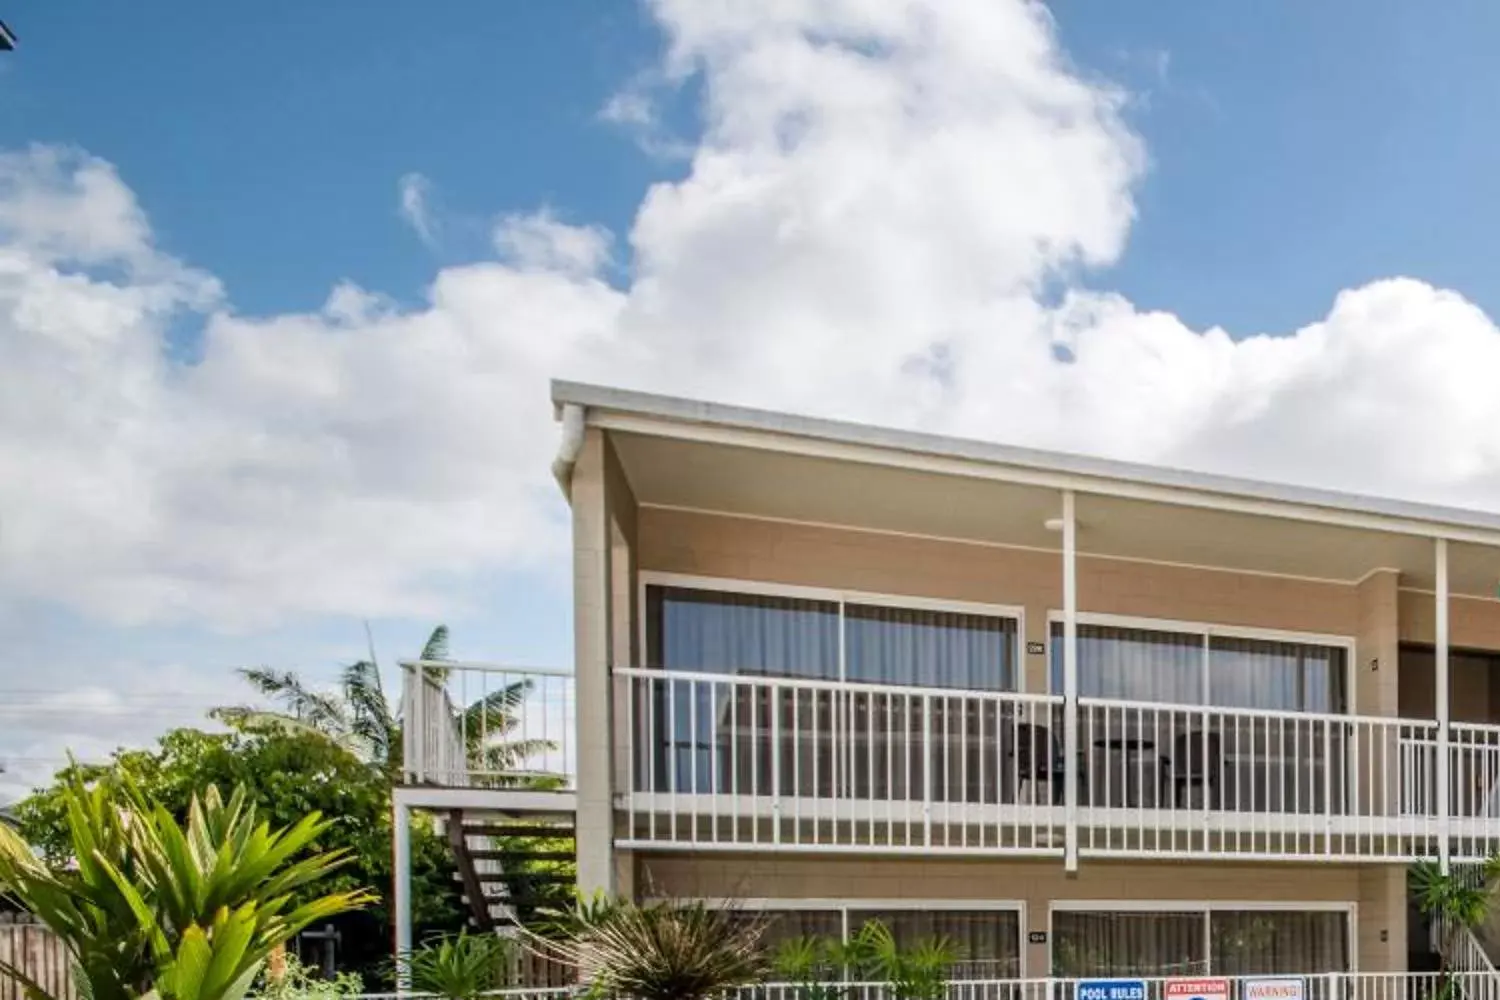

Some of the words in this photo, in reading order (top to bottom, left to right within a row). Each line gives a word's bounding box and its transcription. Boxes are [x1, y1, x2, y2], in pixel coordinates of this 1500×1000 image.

[1169, 983, 1225, 992] ATTENTION
[1249, 986, 1297, 996] WARNING
[1080, 987, 1107, 1000] POOL
[1111, 986, 1143, 999] RULES
